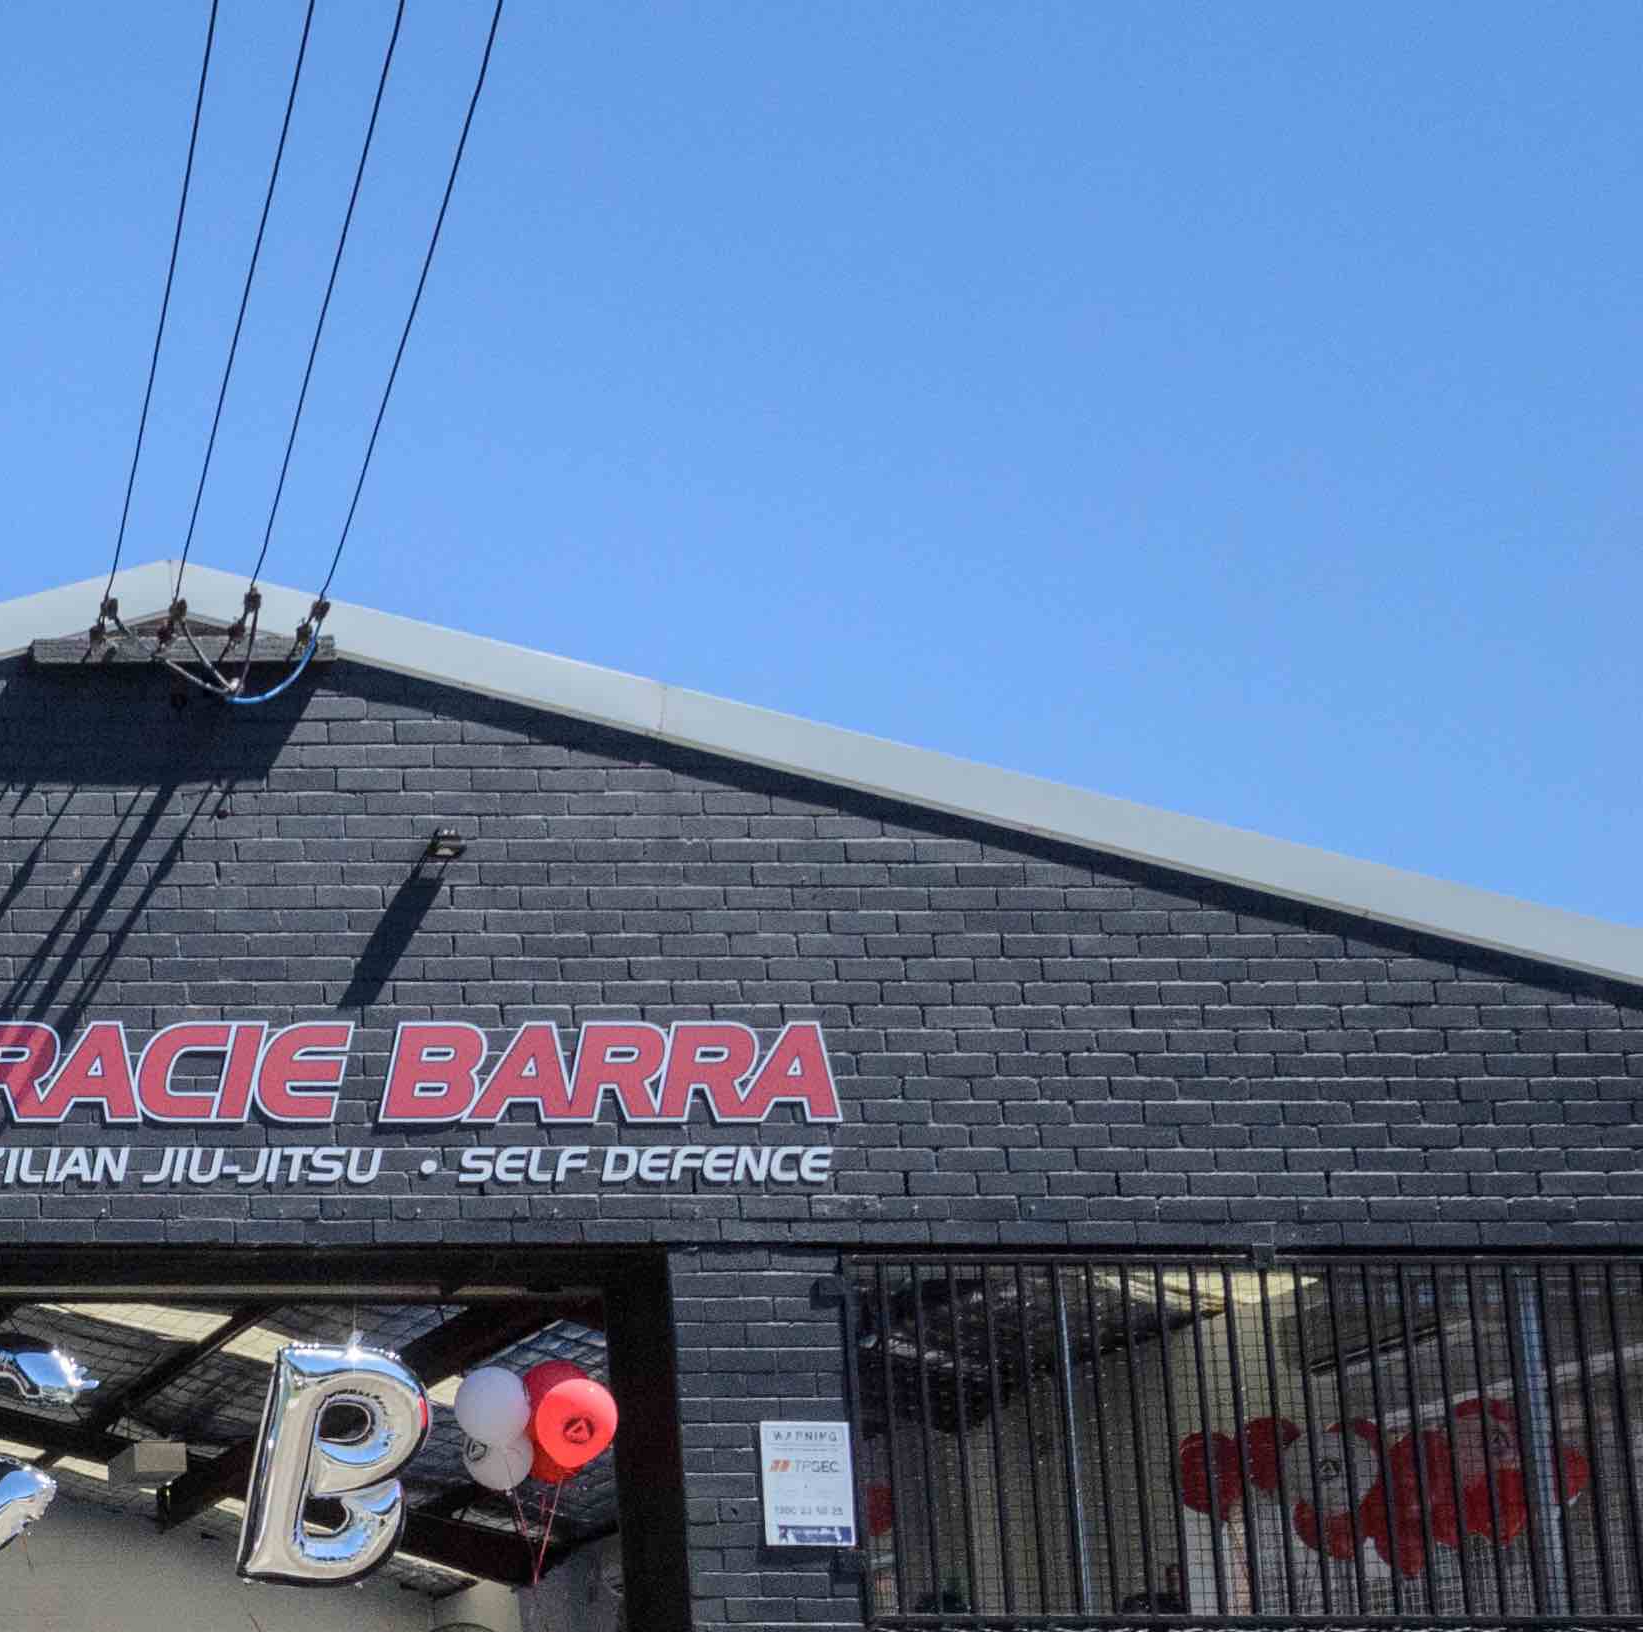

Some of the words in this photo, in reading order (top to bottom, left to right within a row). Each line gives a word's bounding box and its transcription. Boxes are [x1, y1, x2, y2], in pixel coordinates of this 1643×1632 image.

[378, 1021, 843, 1123] BARRA
[142, 1146, 382, 1184] JIU-JITSU
[458, 1146, 589, 1183] SELF
[601, 1146, 834, 1183] DEFENCE
